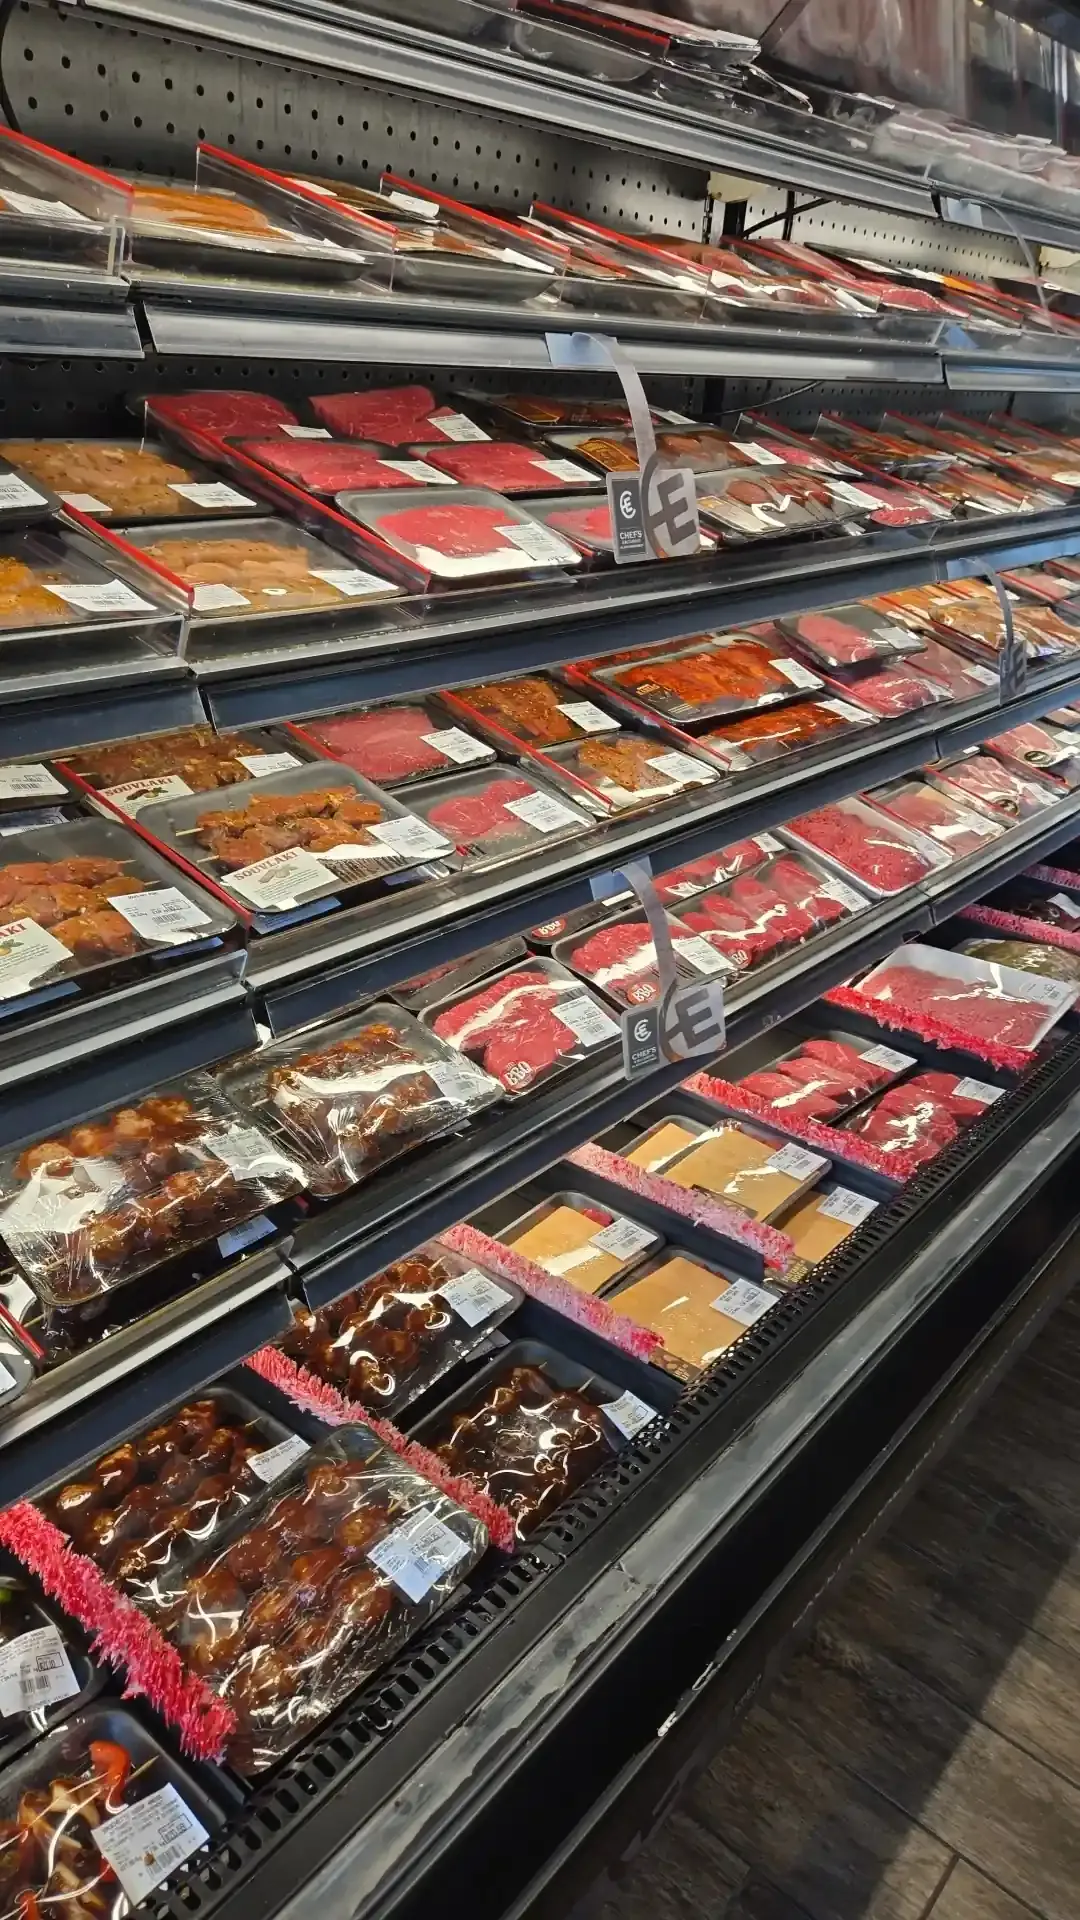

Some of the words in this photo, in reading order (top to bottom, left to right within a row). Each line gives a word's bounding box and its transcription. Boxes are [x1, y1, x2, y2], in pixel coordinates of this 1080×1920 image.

[104, 777, 174, 797] SOUVLAKI
[232, 850, 299, 881] SOUVLAKI
[504, 1061, 533, 1086] BBQ
